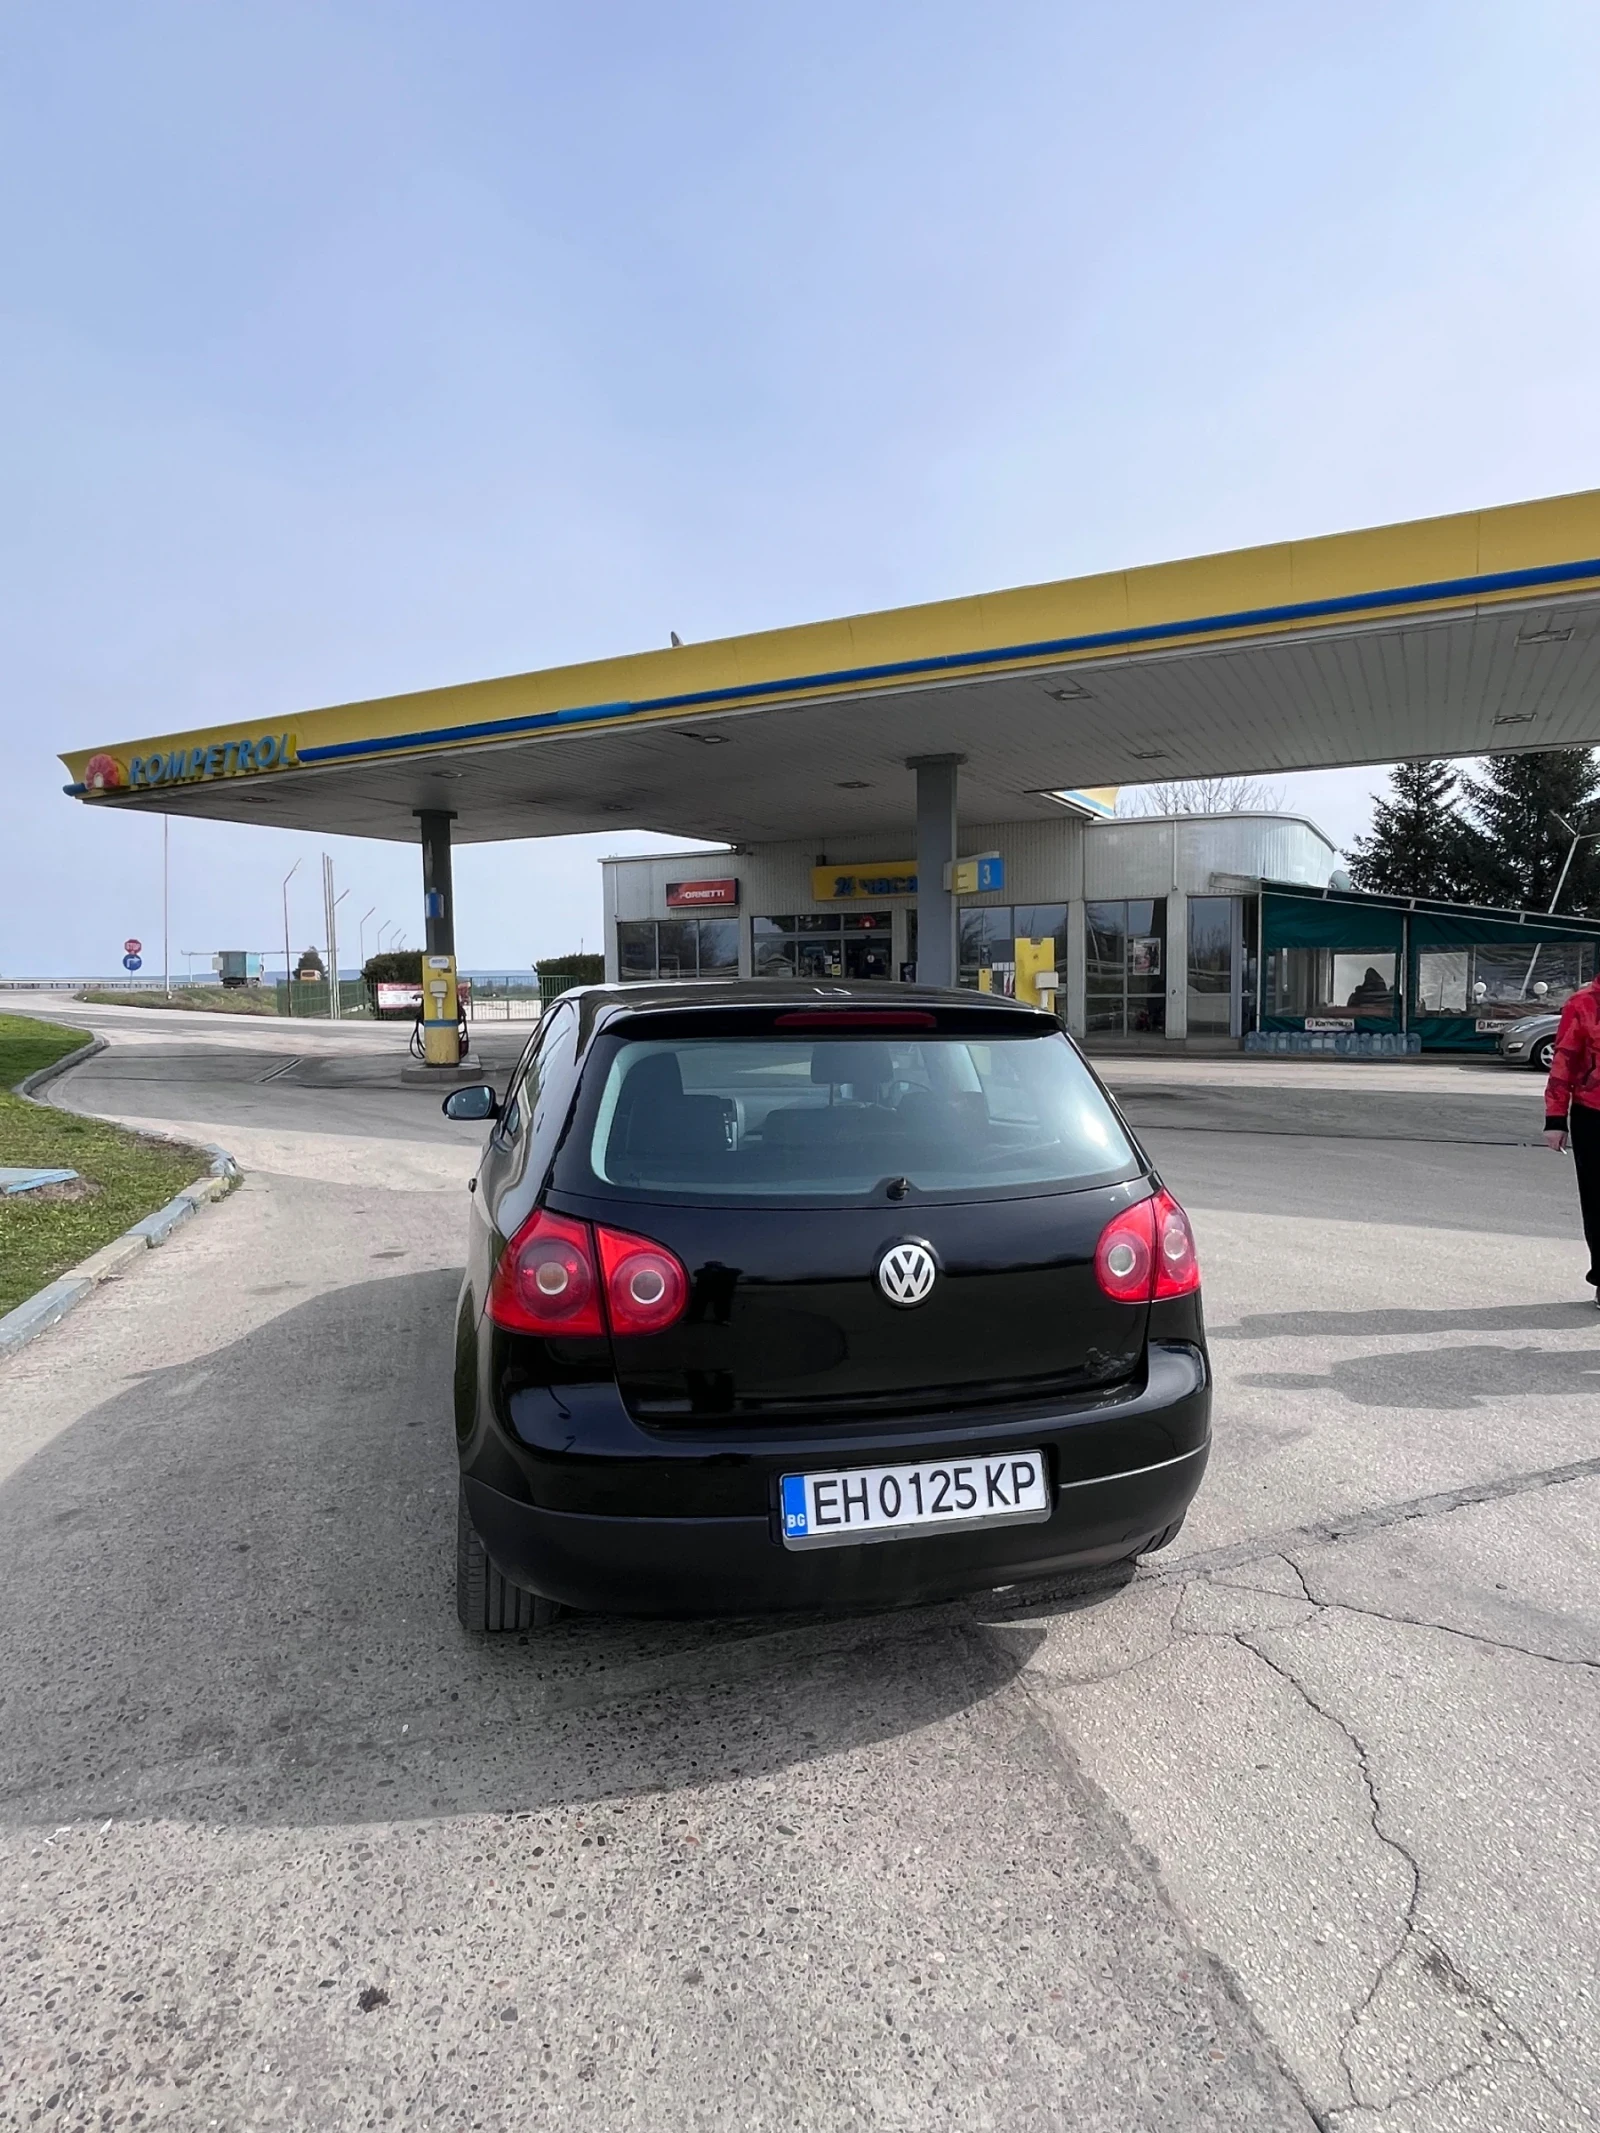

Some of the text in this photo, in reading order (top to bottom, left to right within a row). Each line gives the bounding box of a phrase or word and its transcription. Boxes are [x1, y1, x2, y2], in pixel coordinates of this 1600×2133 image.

[129, 733, 290, 785] ROMPETROL
[983, 864, 991, 885] 3
[787, 1513, 806, 1528] BG
